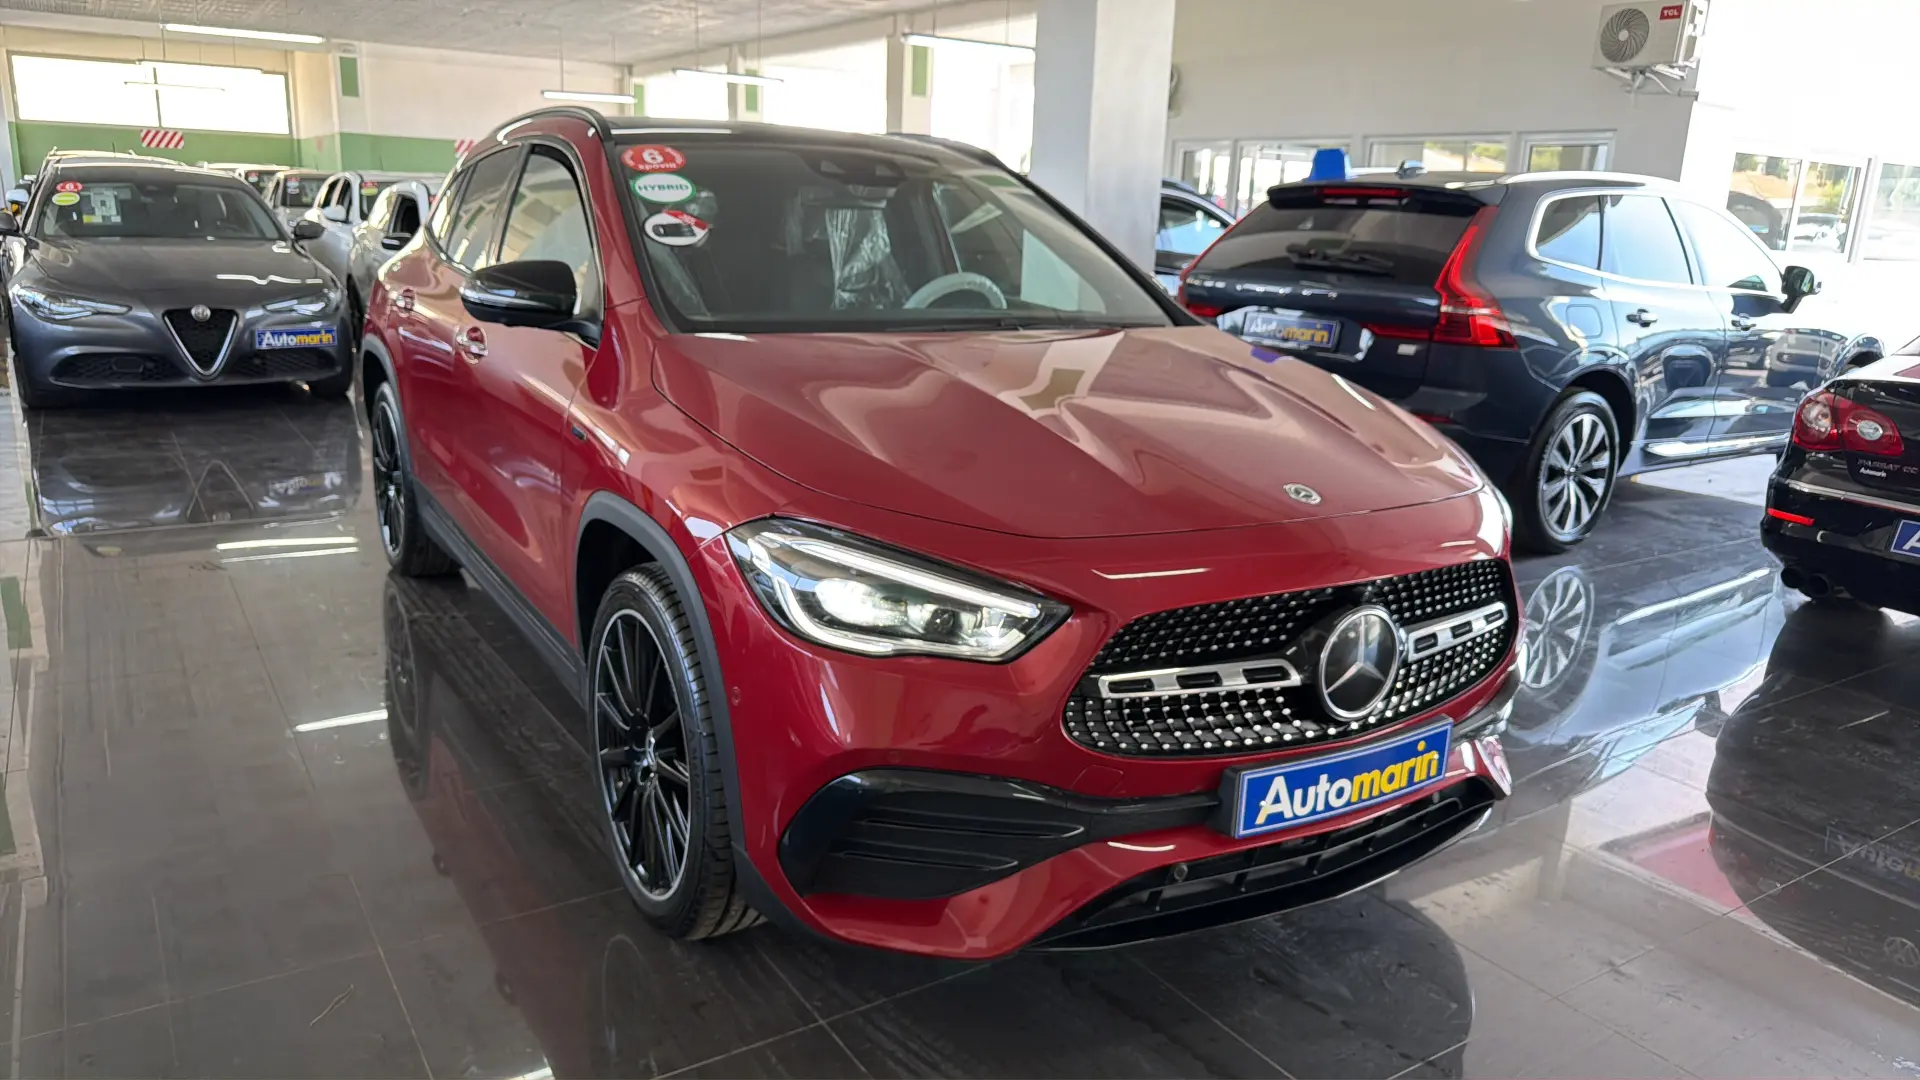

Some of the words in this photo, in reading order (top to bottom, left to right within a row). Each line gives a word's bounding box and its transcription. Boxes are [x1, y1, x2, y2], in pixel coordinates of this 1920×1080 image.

[1663, 8, 1680, 17] TCL
[642, 148, 664, 164] 6
[637, 183, 689, 192] HYBRID
[262, 329, 333, 348] Automarin
[1859, 467, 1887, 478] Automarin
[1254, 740, 1439, 825] Automarin
